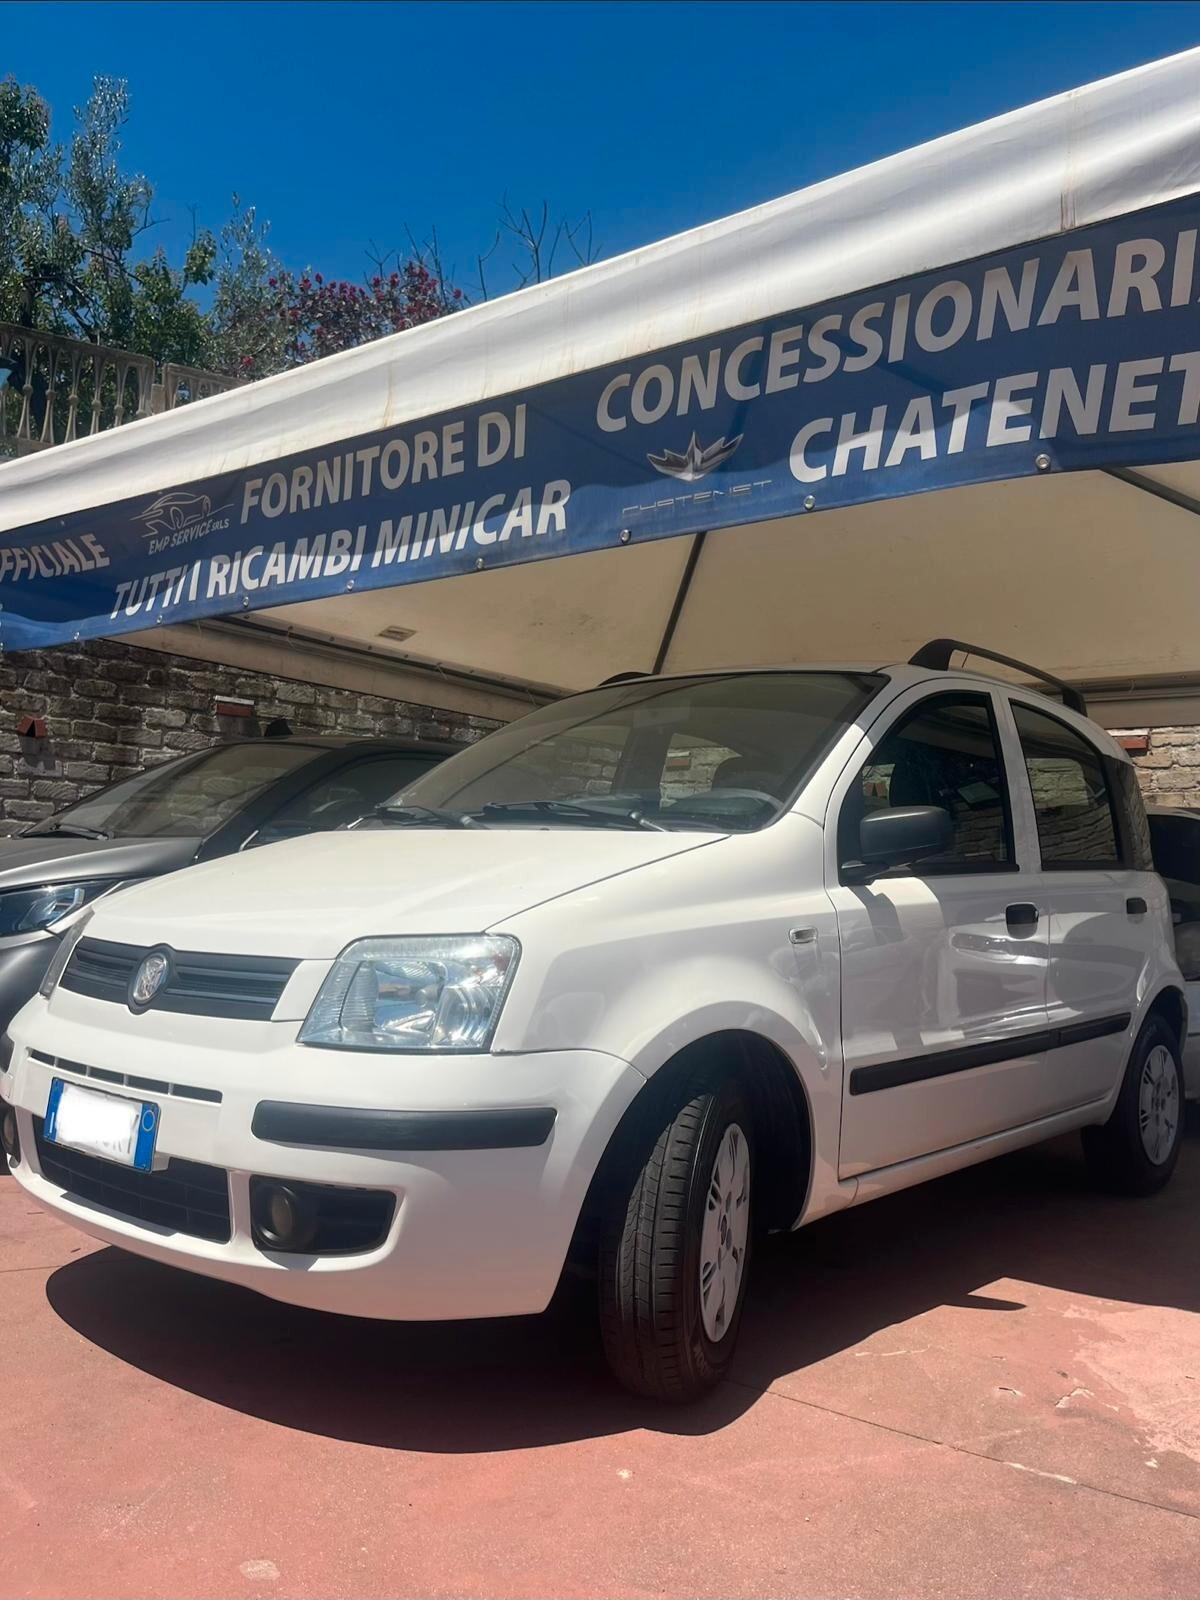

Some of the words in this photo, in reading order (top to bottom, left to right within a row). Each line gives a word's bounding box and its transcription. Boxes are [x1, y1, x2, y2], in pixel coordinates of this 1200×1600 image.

[596, 228, 1200, 433] CONCESSIONARI
[240, 420, 465, 524] FORNITORE
[477, 404, 527, 467] DI
[789, 351, 1200, 484] CHATENET
[109, 564, 189, 619] TUTTI
[188, 559, 202, 602] I
[206, 526, 367, 599] RICAMBI
[371, 479, 571, 565] MINICAR
[148, 536, 171, 555] EMP
[170, 518, 212, 548] SERVICE
